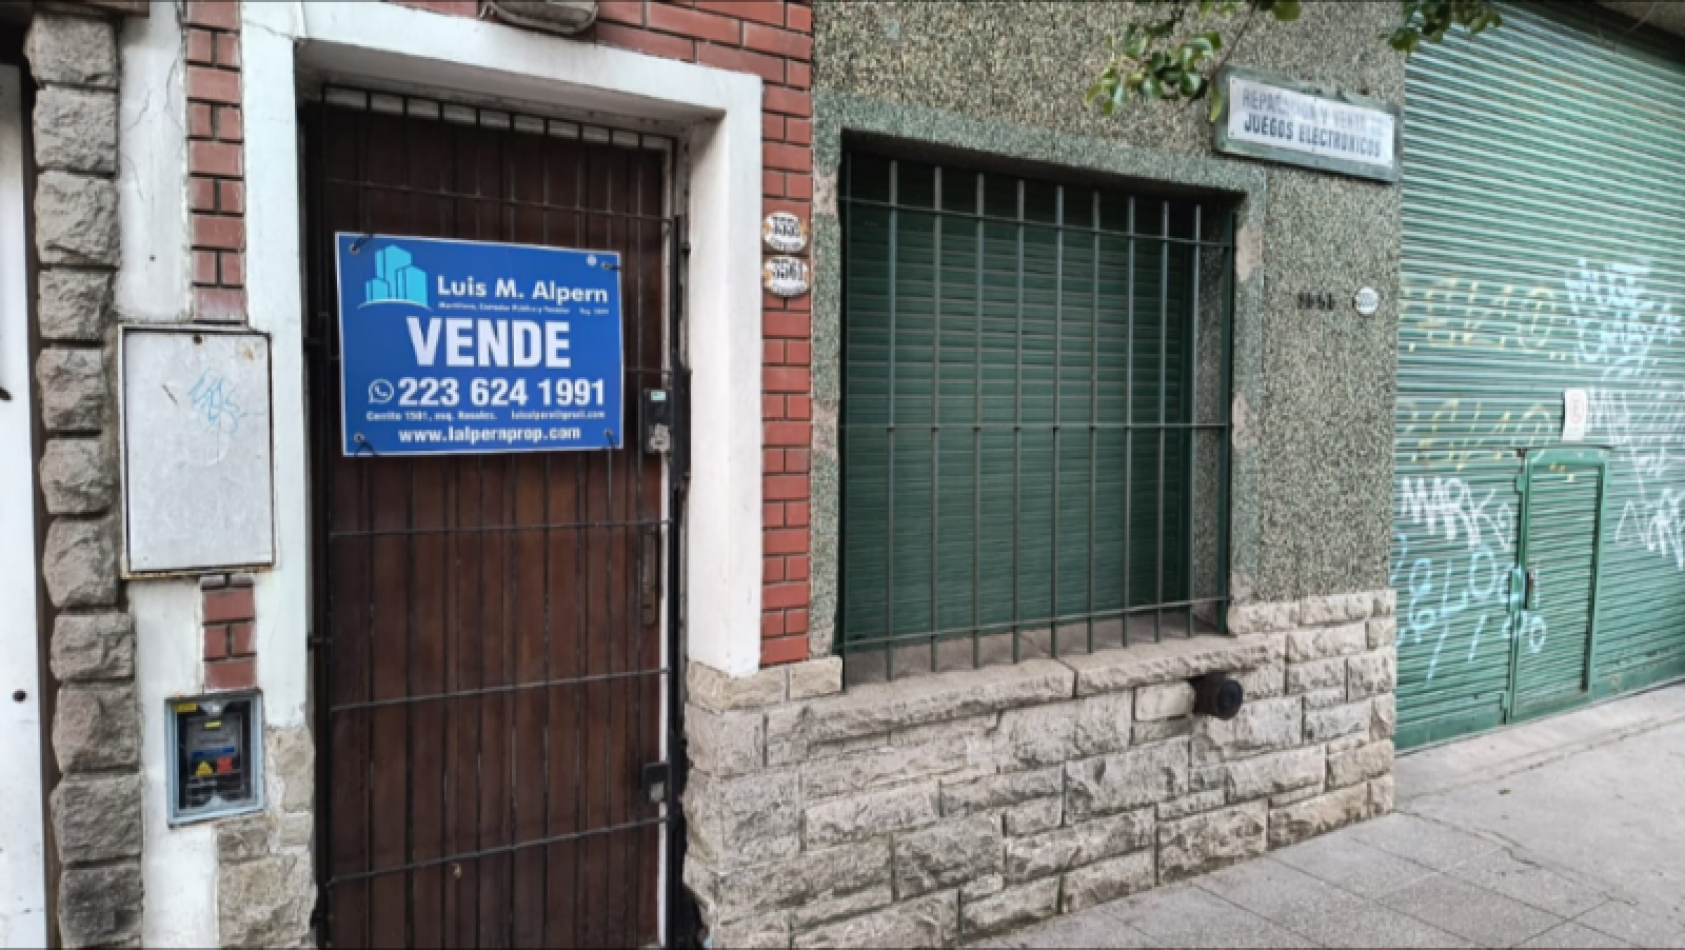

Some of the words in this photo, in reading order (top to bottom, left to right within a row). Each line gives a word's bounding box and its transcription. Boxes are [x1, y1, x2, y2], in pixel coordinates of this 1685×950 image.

[1244, 113, 1294, 141] JUEGOS
[1298, 123, 1381, 158] ELECTRONICOS
[437, 275, 487, 297] Luis
[495, 279, 525, 298] M.
[532, 280, 608, 305] Alpern
[406, 316, 571, 368] VENDE
[398, 377, 460, 407] 223
[470, 378, 528, 407] 624
[537, 379, 605, 406] 1991
[398, 427, 581, 444] www.lalpernprop.com
